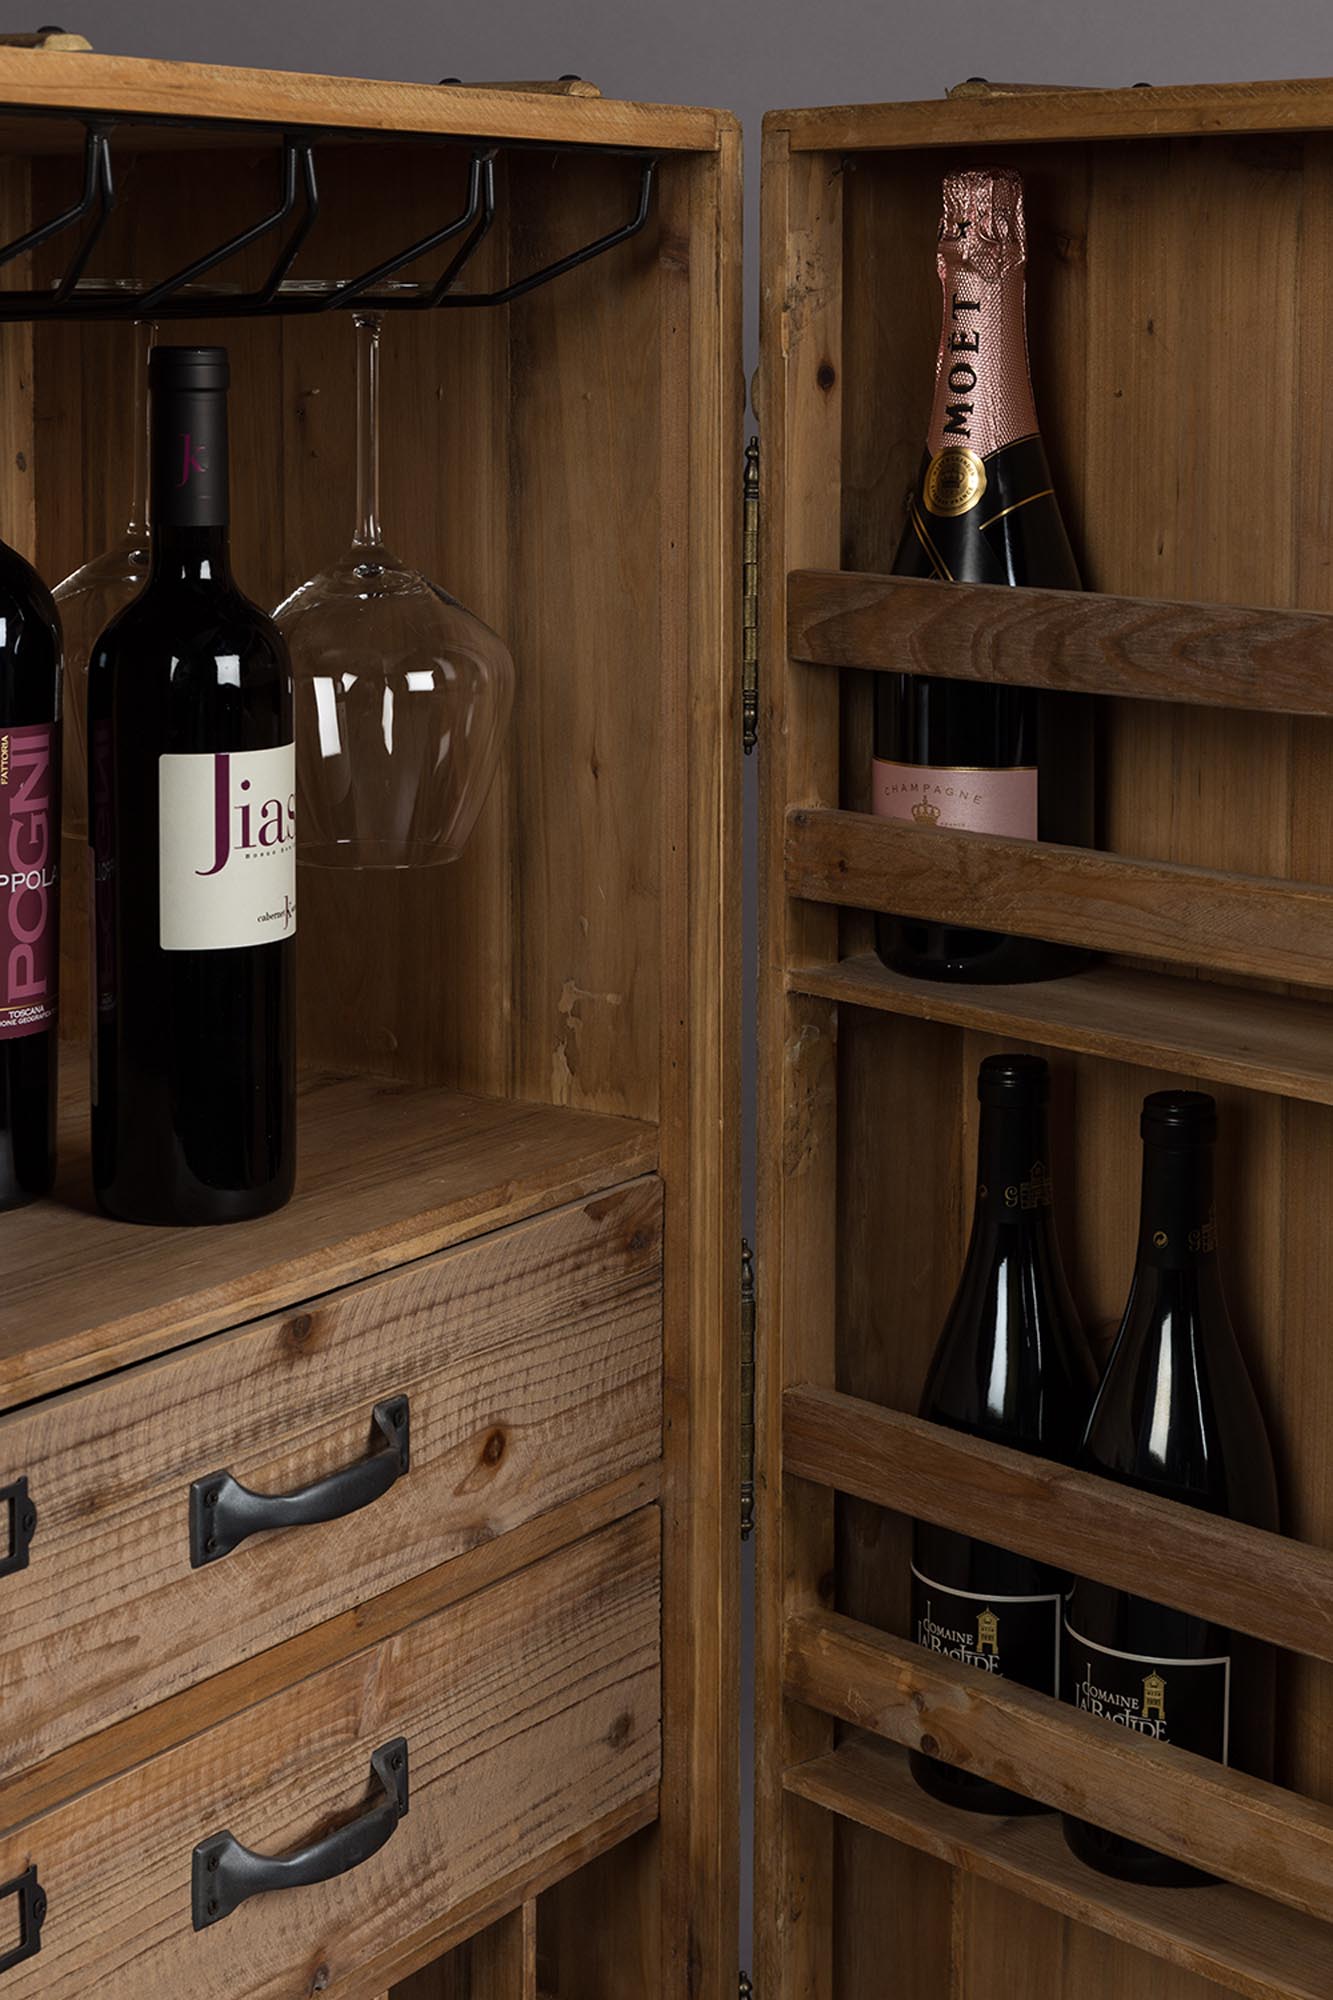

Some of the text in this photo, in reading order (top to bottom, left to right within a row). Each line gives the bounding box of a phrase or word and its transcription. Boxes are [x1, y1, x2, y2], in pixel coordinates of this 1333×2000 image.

[0, 735, 9, 785] FATTORIA
[883, 783, 984, 805] CHAMPAGNE
[7, 732, 51, 1003] POGNI
